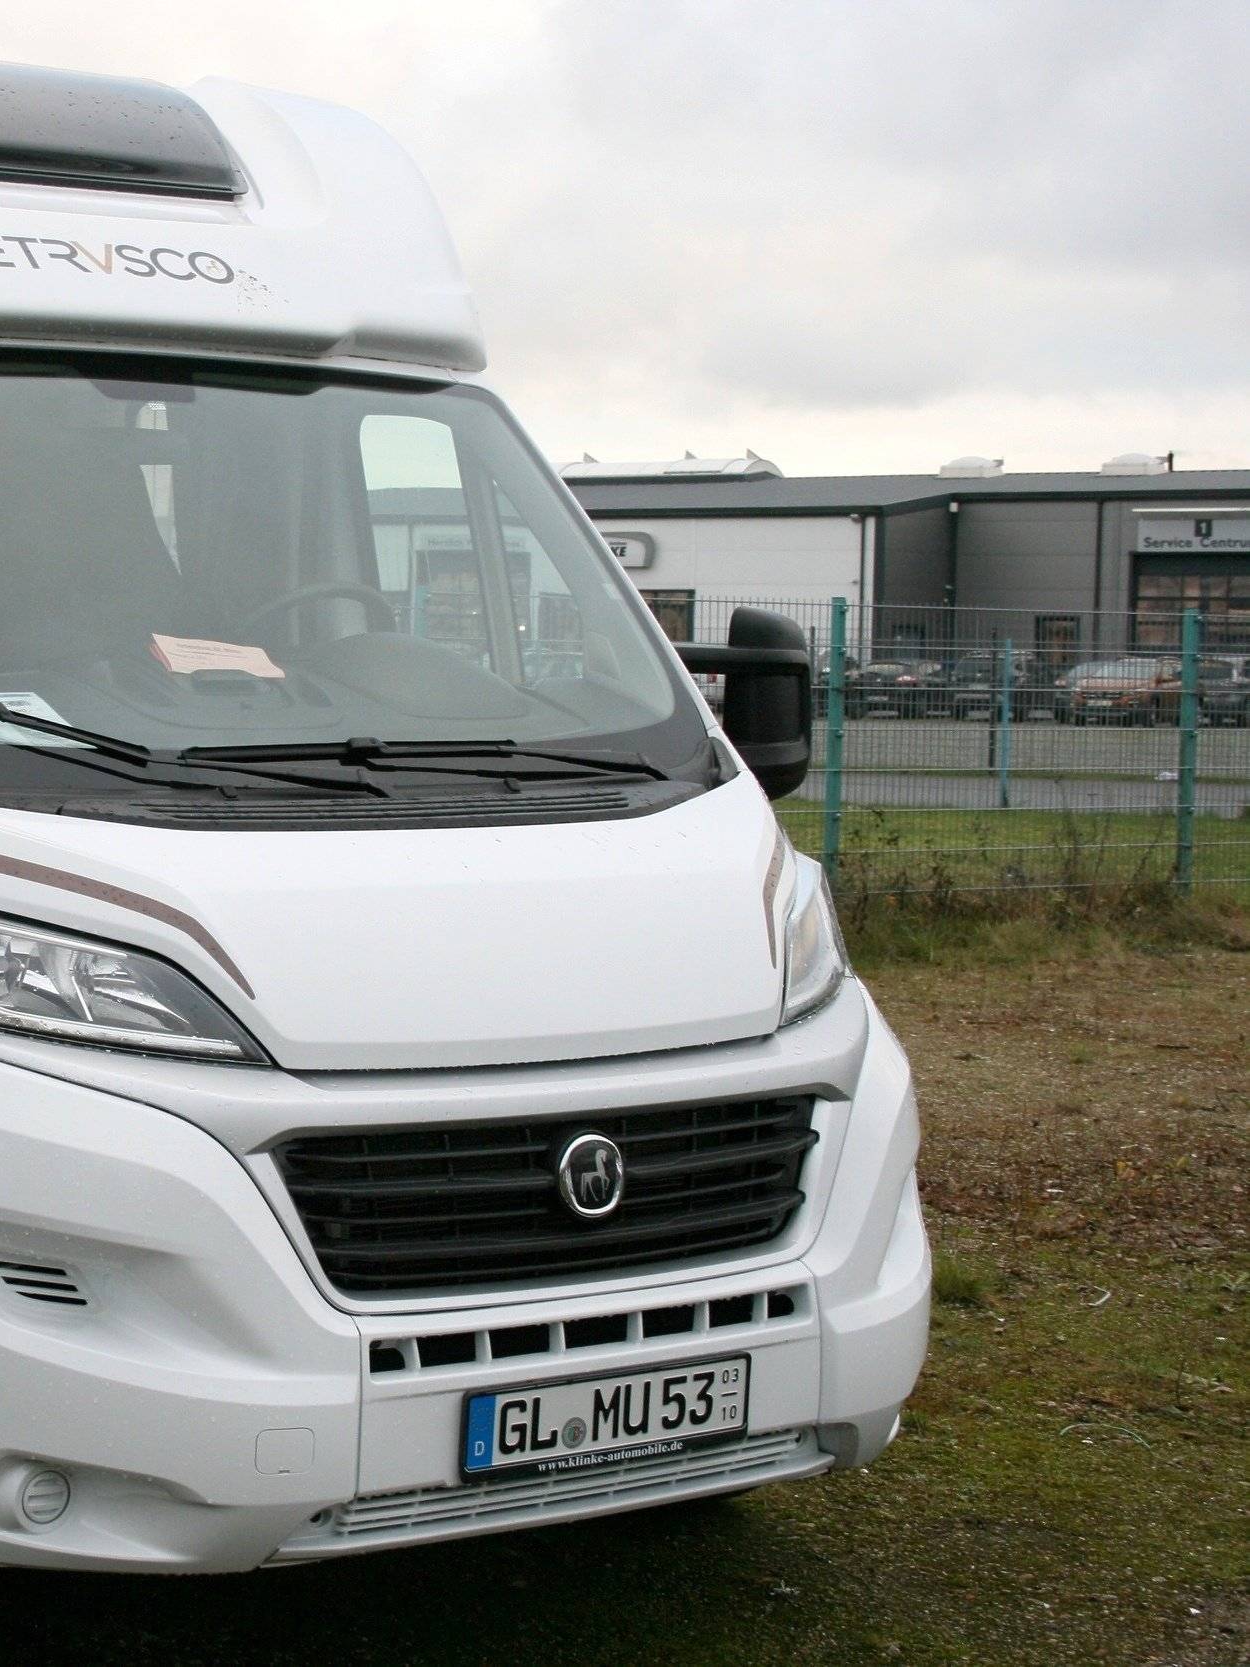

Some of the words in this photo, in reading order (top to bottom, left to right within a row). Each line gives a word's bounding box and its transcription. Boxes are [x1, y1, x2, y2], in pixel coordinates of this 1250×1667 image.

[1199, 521, 1208, 535] 1
[1143, 537, 1192, 548] Service
[722, 1368, 739, 1384] 03
[473, 1440, 485, 1457] D
[500, 1396, 558, 1454] GL
[592, 1380, 652, 1442] MU
[661, 1371, 715, 1430] 53
[722, 1405, 737, 1421] 10
[538, 1441, 683, 1472] www.klinke-automobile.de
